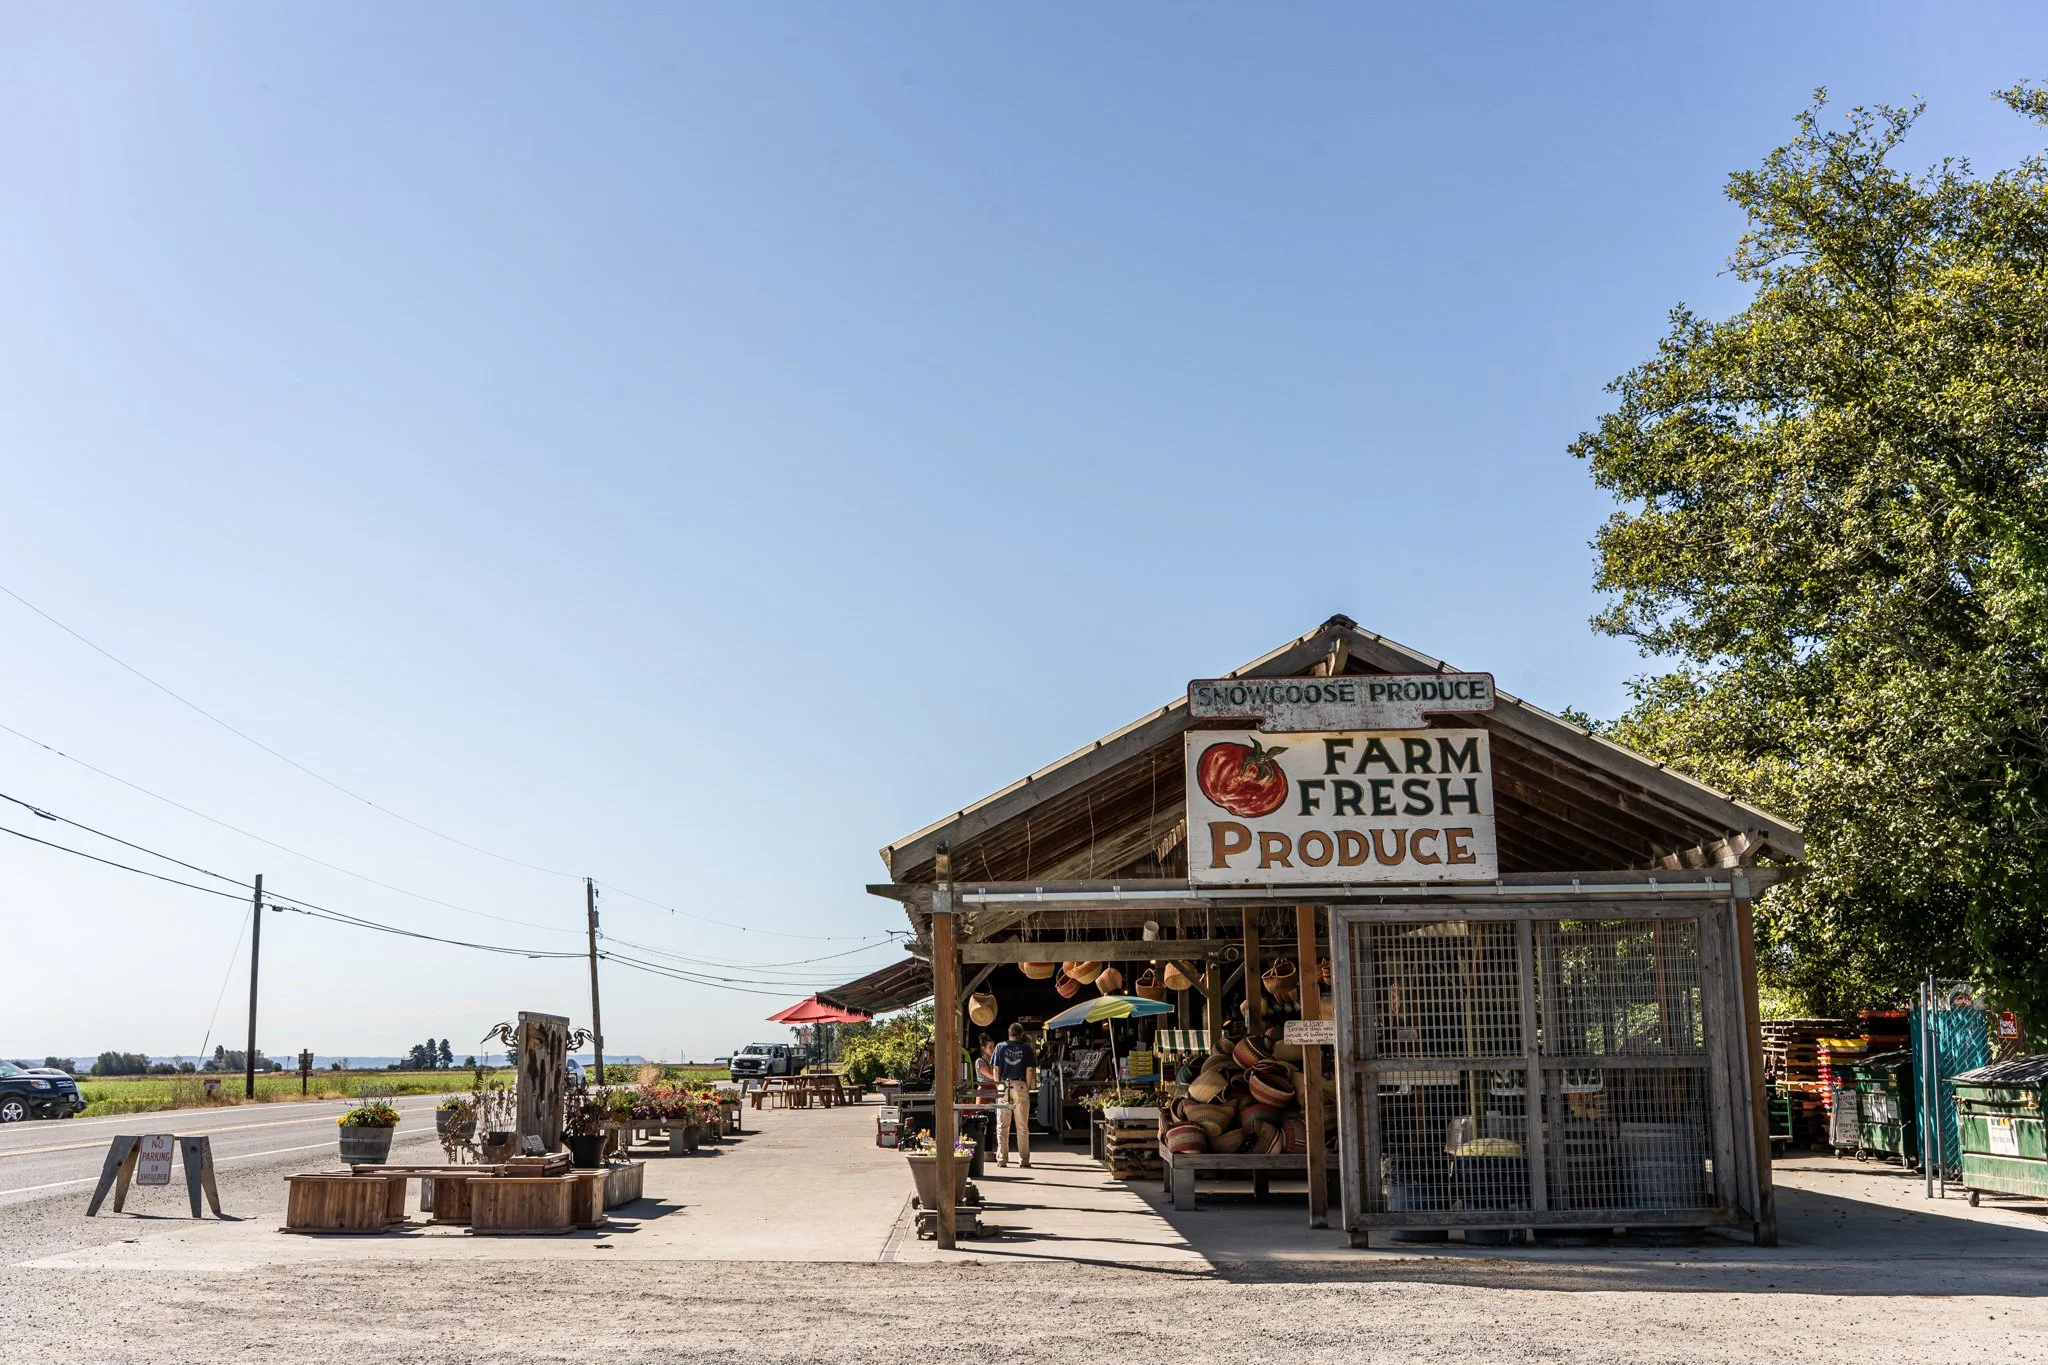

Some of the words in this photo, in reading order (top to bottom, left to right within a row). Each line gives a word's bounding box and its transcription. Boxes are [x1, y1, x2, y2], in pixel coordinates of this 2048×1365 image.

[1198, 684, 1354, 706] SNOWGOOSE
[1369, 681, 1485, 701] PRODUCE
[1322, 737, 1482, 775] FARM
[1297, 777, 1482, 817] FRESH
[1208, 821, 1477, 870] PRODUCE
[141, 1151, 170, 1162] PARKING
[151, 1139, 164, 1149] NO
